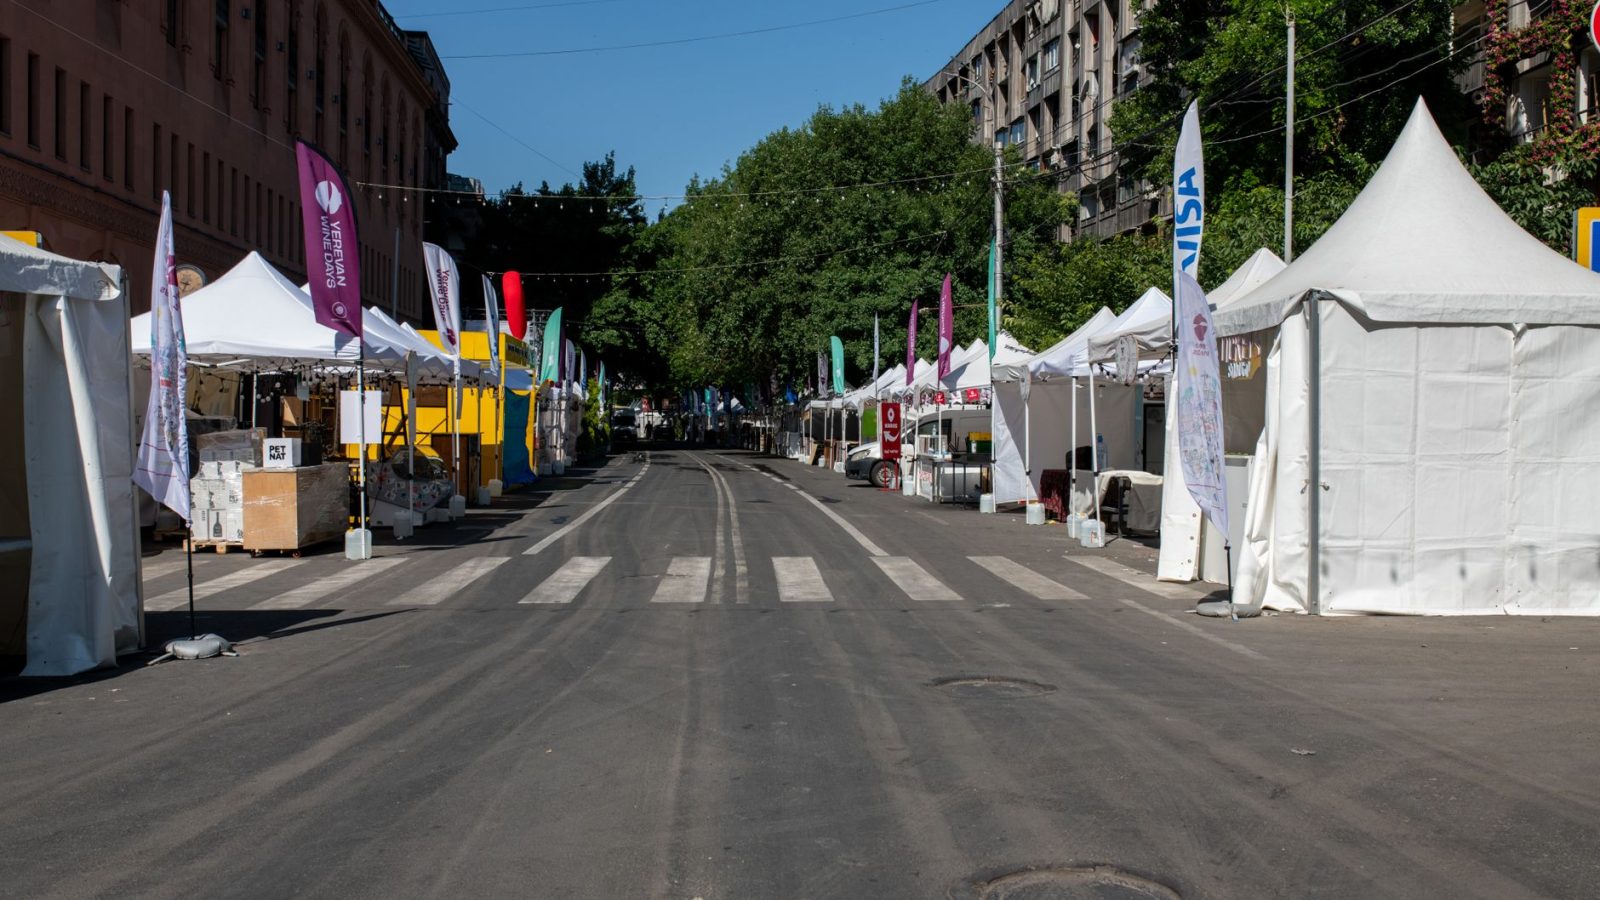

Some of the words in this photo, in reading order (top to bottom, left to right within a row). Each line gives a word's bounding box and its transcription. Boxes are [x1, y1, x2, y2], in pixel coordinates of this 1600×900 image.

[320, 216, 331, 250] WINE
[1176, 167, 1201, 271] VISA
[323, 253, 335, 288] DAYS
[330, 221, 346, 286] YEREVAN
[269, 445, 286, 453] PET
